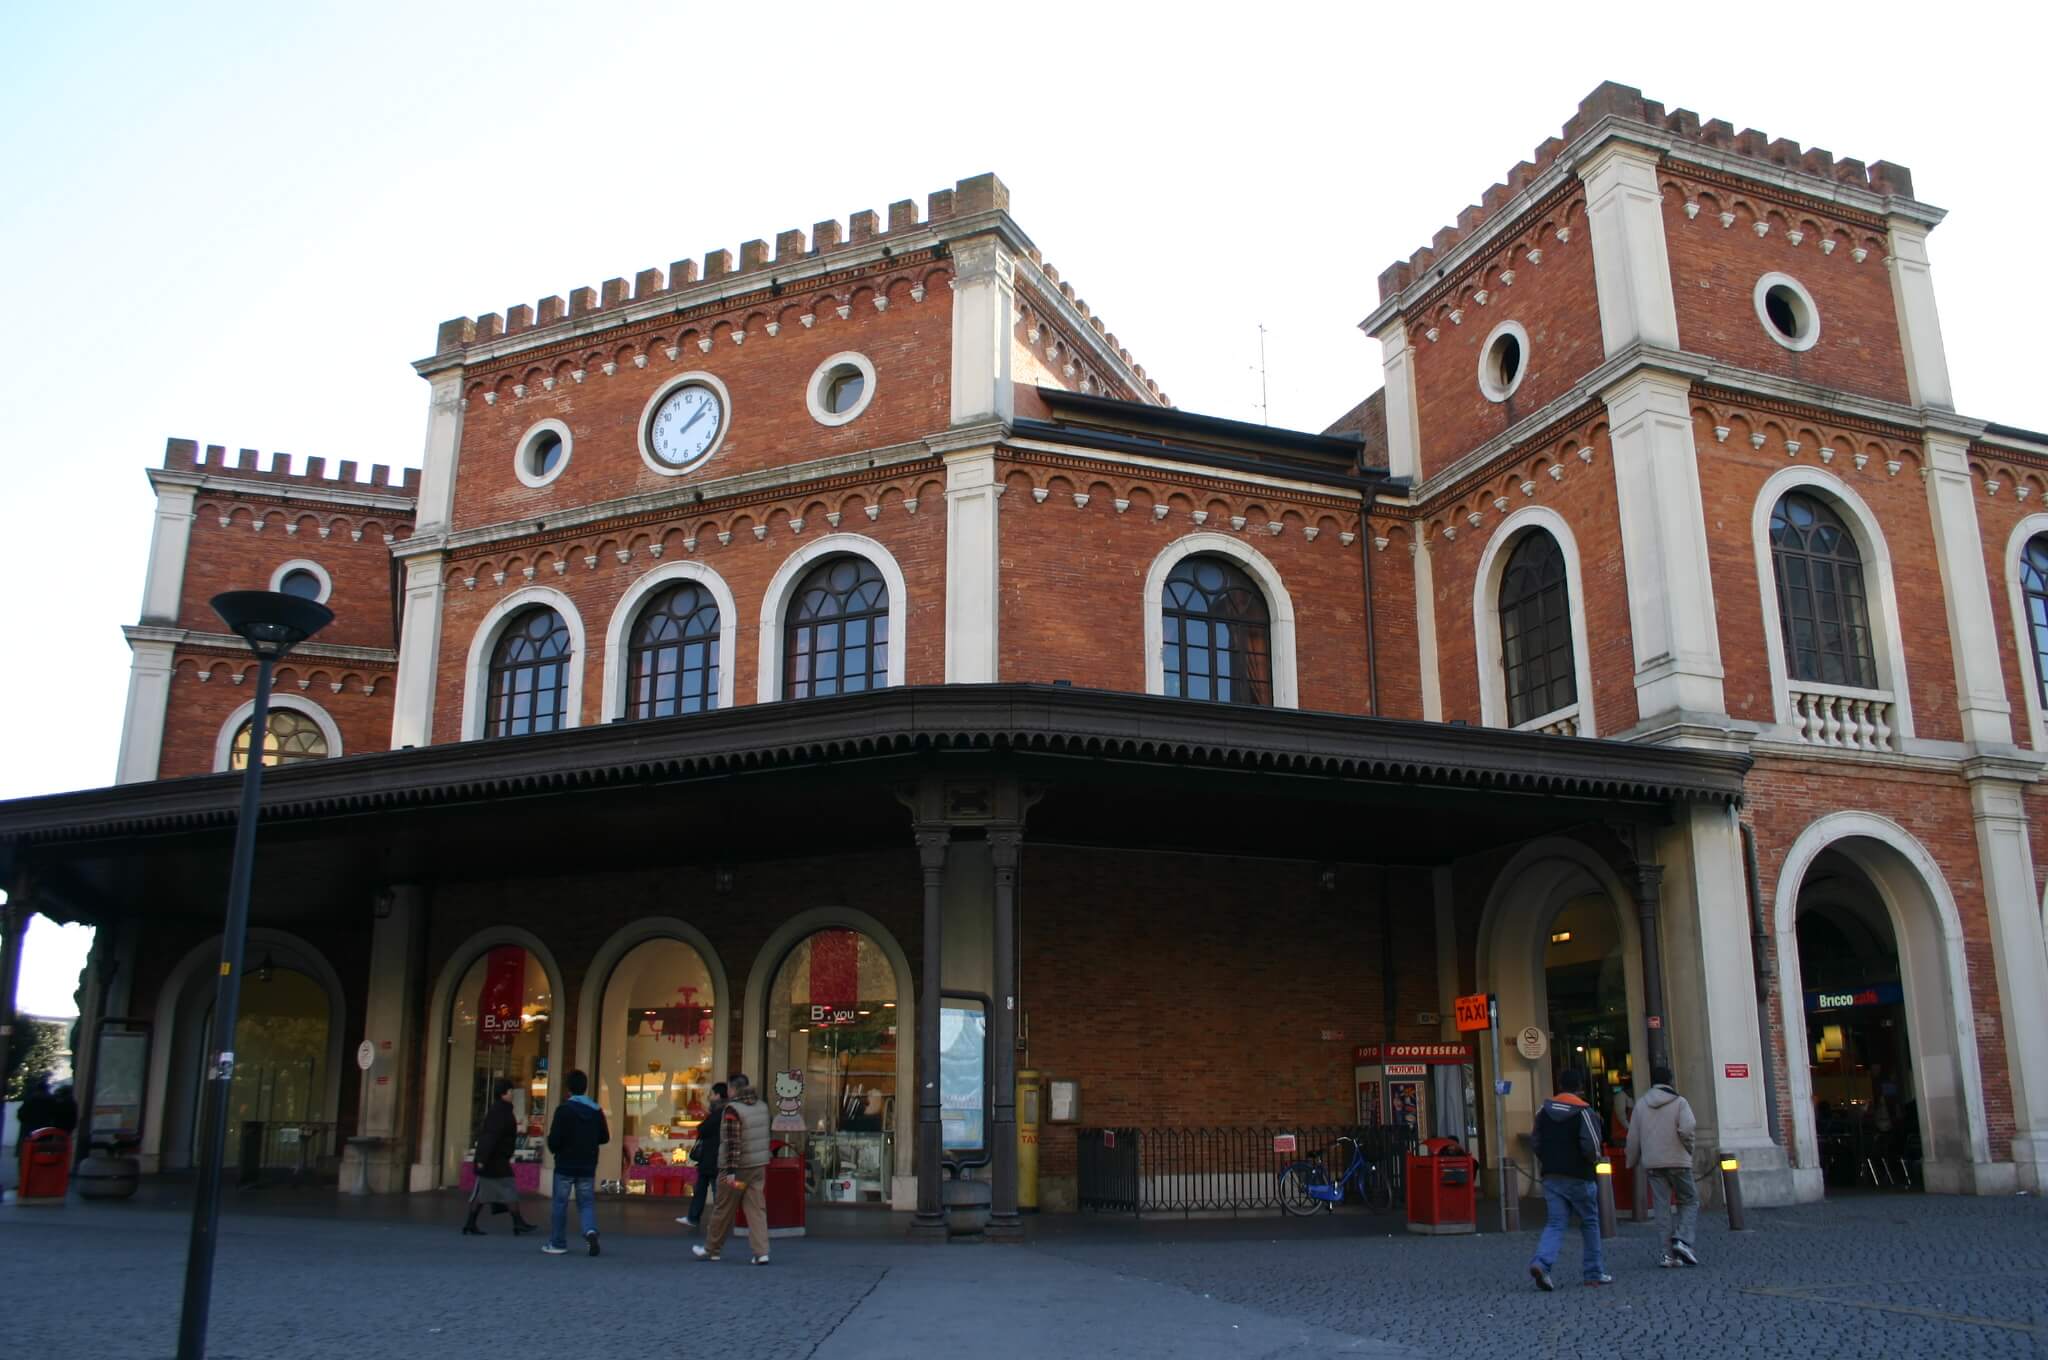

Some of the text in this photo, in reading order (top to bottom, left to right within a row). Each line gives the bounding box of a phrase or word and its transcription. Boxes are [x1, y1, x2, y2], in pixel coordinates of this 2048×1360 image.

[1457, 1003, 1486, 1022] TAXI
[1390, 1046, 1466, 1056] FOTOTESSERA
[1022, 1135, 1040, 1144] TAX
